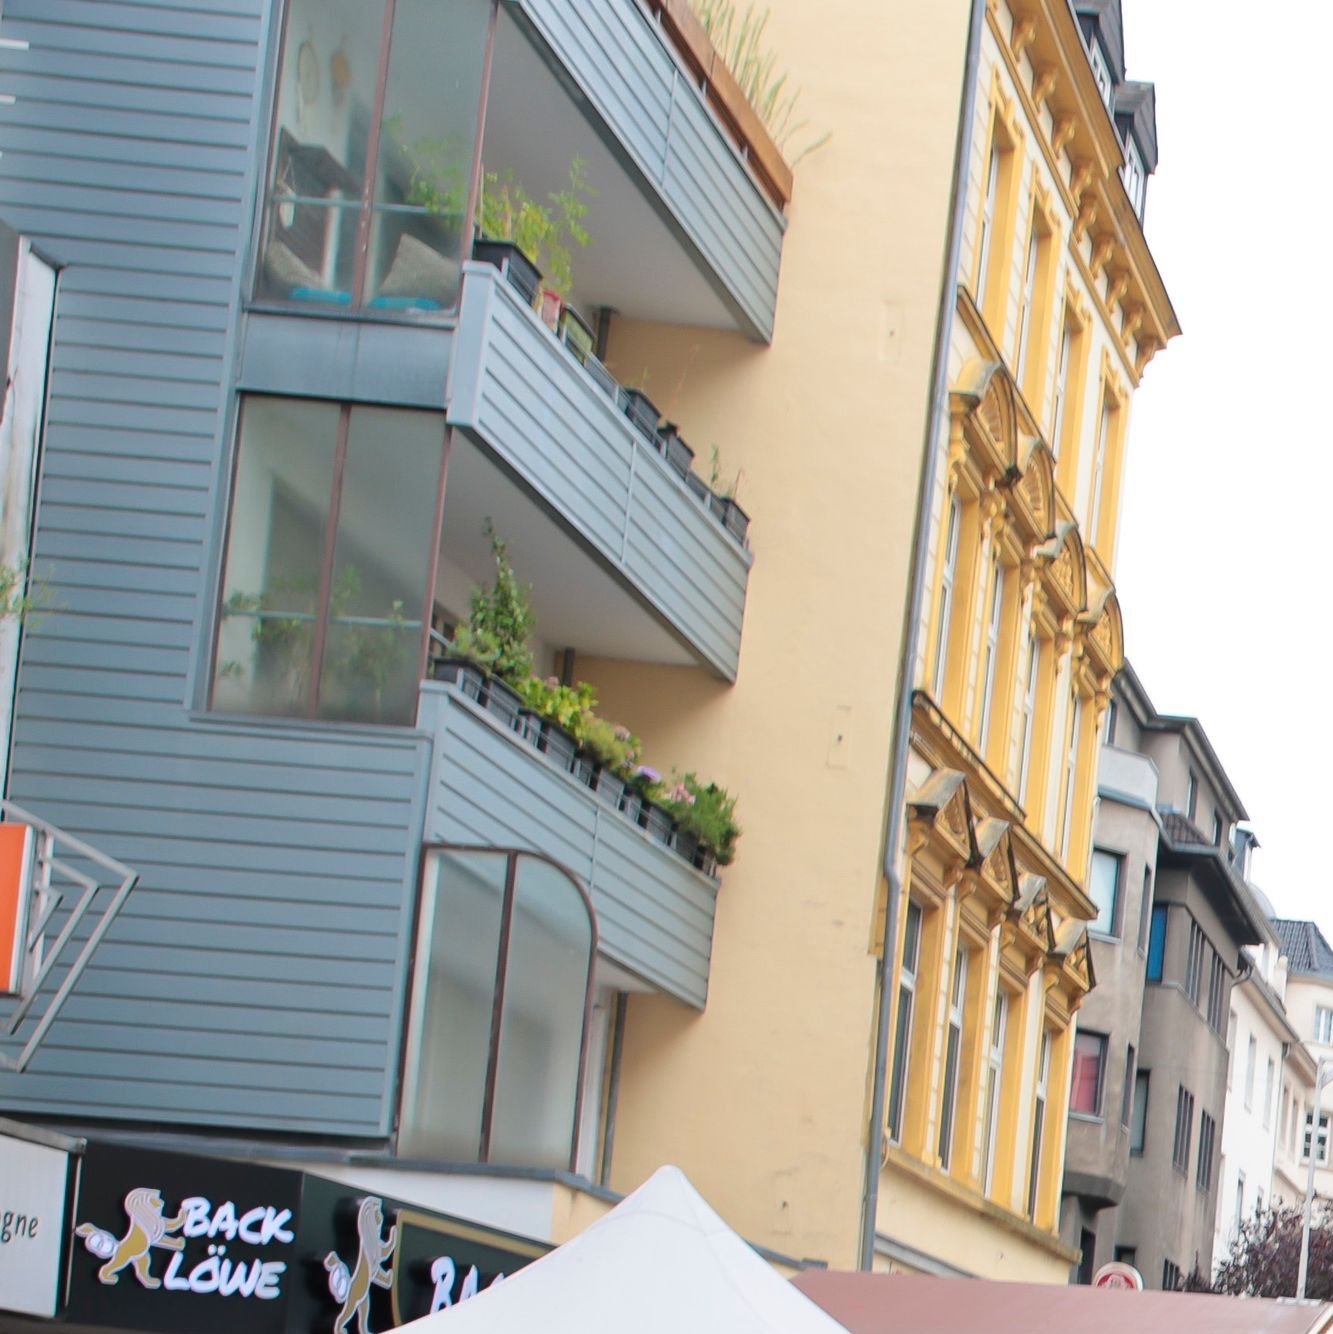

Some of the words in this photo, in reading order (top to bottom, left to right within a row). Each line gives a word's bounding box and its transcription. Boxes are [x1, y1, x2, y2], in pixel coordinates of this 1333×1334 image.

[0, 1209, 39, 1243] gne
[181, 1196, 294, 1245] BACK
[163, 1245, 287, 1300] LÖWE
[430, 1256, 505, 1314] BA
